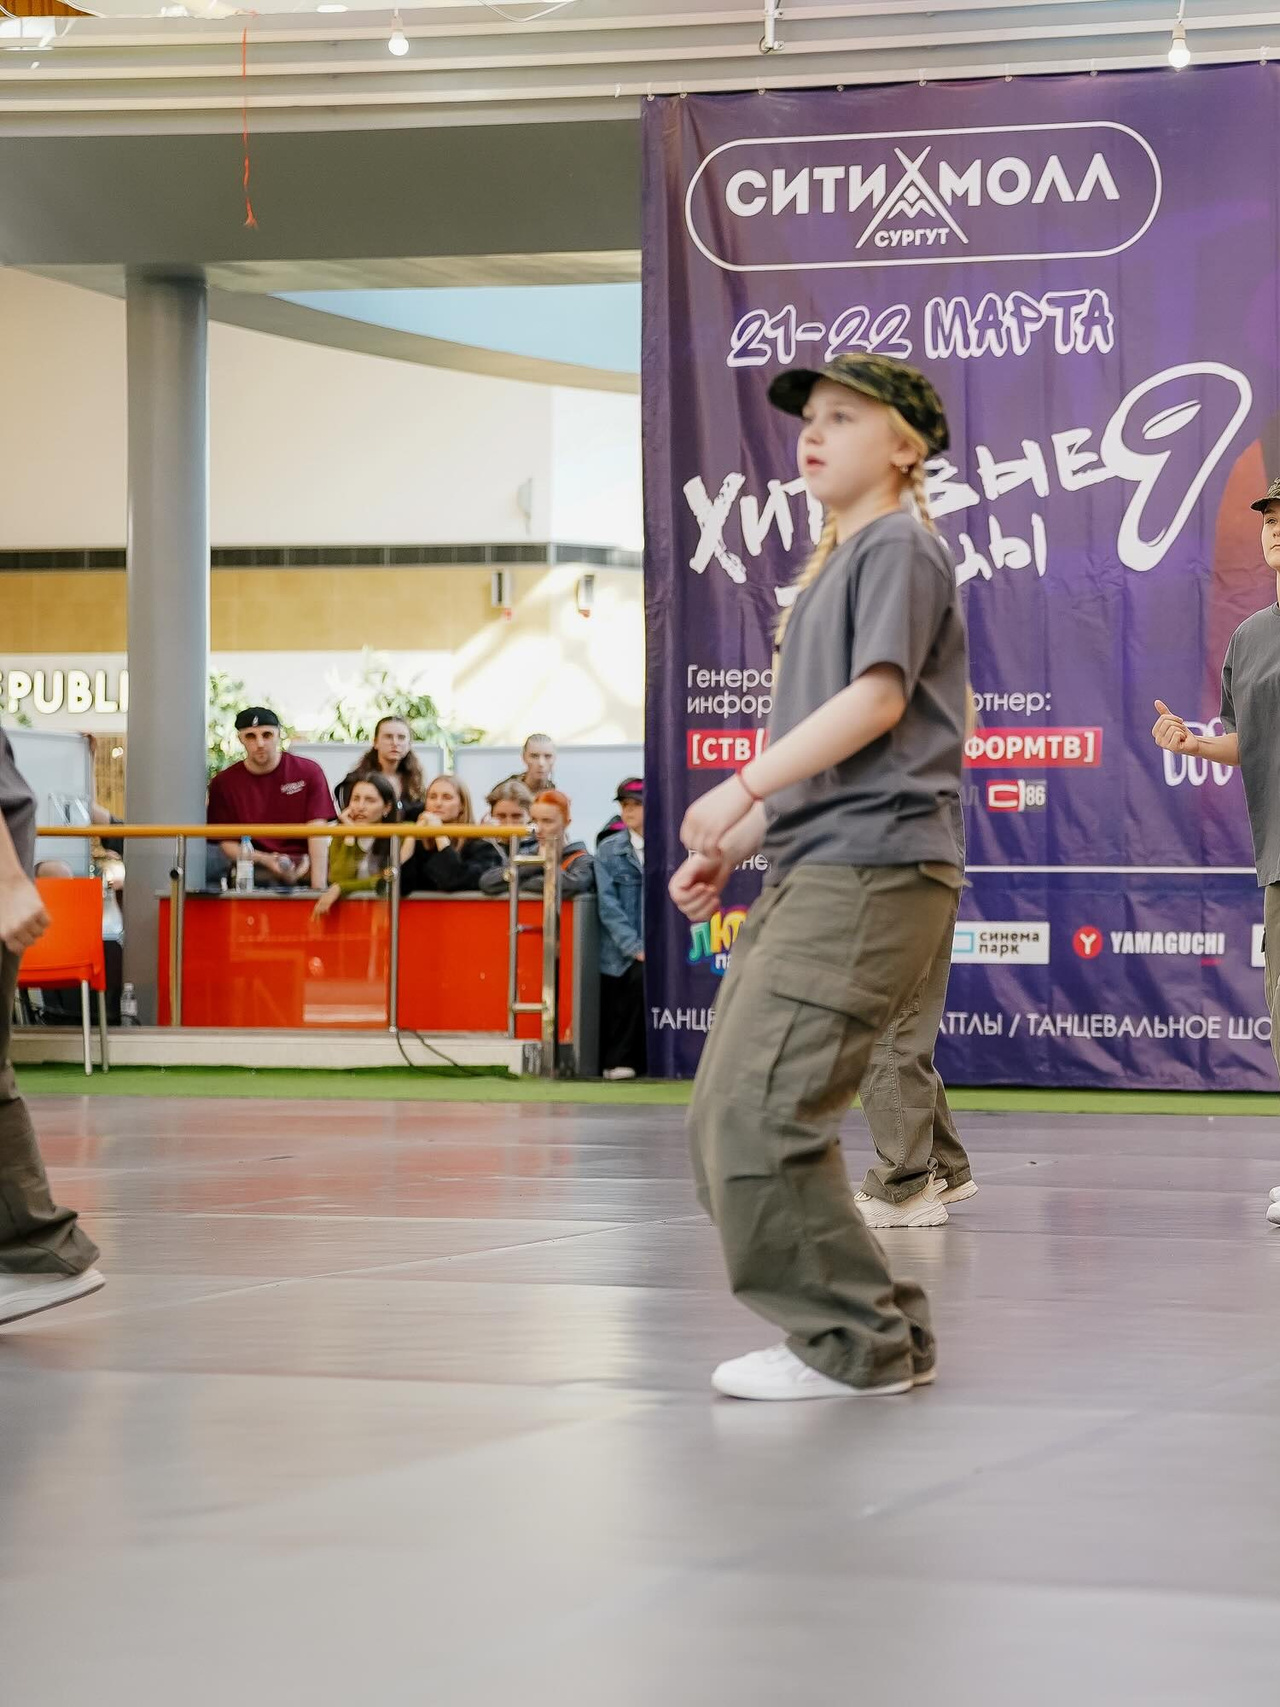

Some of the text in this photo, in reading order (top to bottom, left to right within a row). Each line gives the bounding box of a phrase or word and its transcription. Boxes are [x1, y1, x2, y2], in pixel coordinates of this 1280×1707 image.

[874, 227, 950, 248] СУРГУТ
[726, 288, 1115, 367] 21-22 МАРТА
[0, 669, 129, 714] PUBLI
[979, 931, 1040, 943] синема
[1111, 931, 1225, 955] YAMAGUCHI
[979, 944, 1019, 957] парк
[1027, 1013, 1221, 1040] ТАНЦЕВАЛЬНОЕ
[1228, 1016, 1272, 1040] ШО
